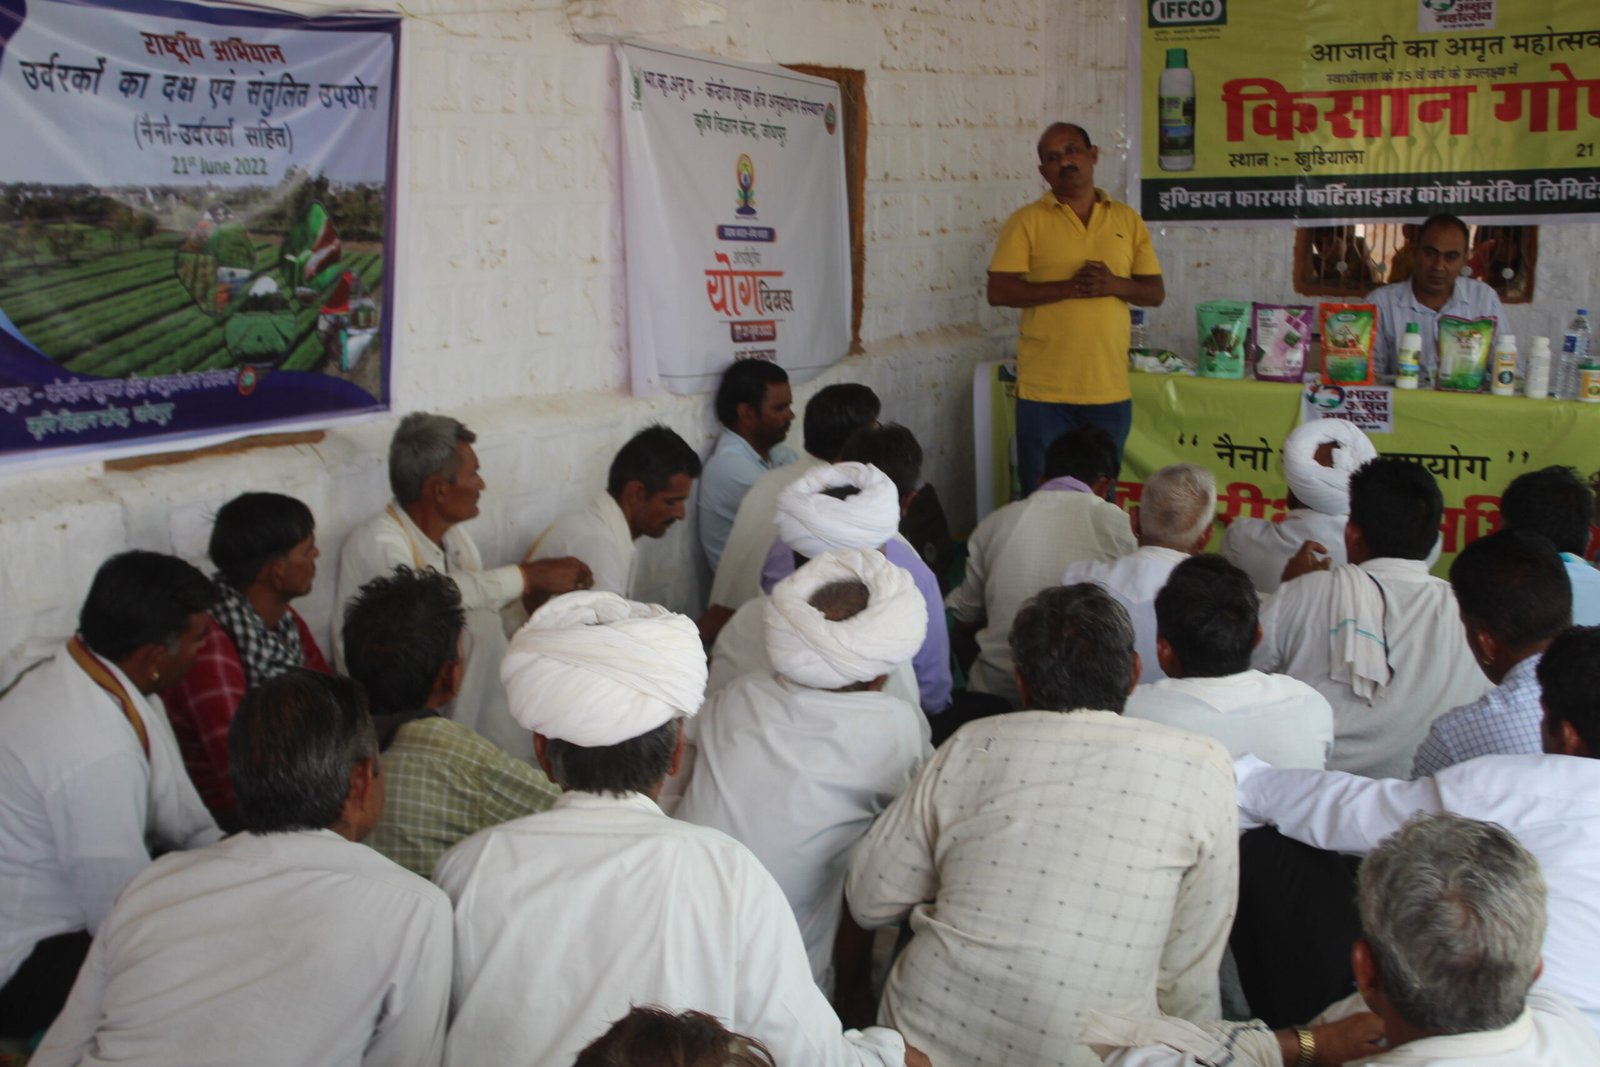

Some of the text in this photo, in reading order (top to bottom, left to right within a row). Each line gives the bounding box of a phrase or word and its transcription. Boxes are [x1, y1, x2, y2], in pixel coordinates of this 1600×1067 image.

[1160, 0, 1215, 19] IFFCO
[140, 31, 286, 64] राष्ट्रीय अभियान
[1310, 34, 1398, 63] आजादी
[1403, 39, 1439, 59] का
[1444, 35, 1505, 63] अमृत
[19, 53, 378, 116] उर्वरकों का दक्ष एवं संतुलित उपयोग
[1398, 71, 1412, 82] 75
[1221, 77, 1477, 142] किसान
[1228, 150, 1270, 168] स्थान
[1576, 143, 1594, 157] 21
[172, 156, 268, 175] 21st June 2022
[1158, 187, 1233, 210] इण्डियन
[1305, 182, 1413, 207] फर्टिलाइजर
[1417, 178, 1531, 206] कोऑपरेटिव
[704, 251, 795, 317] योग दिवस
[1213, 433, 1273, 472] नैनो
